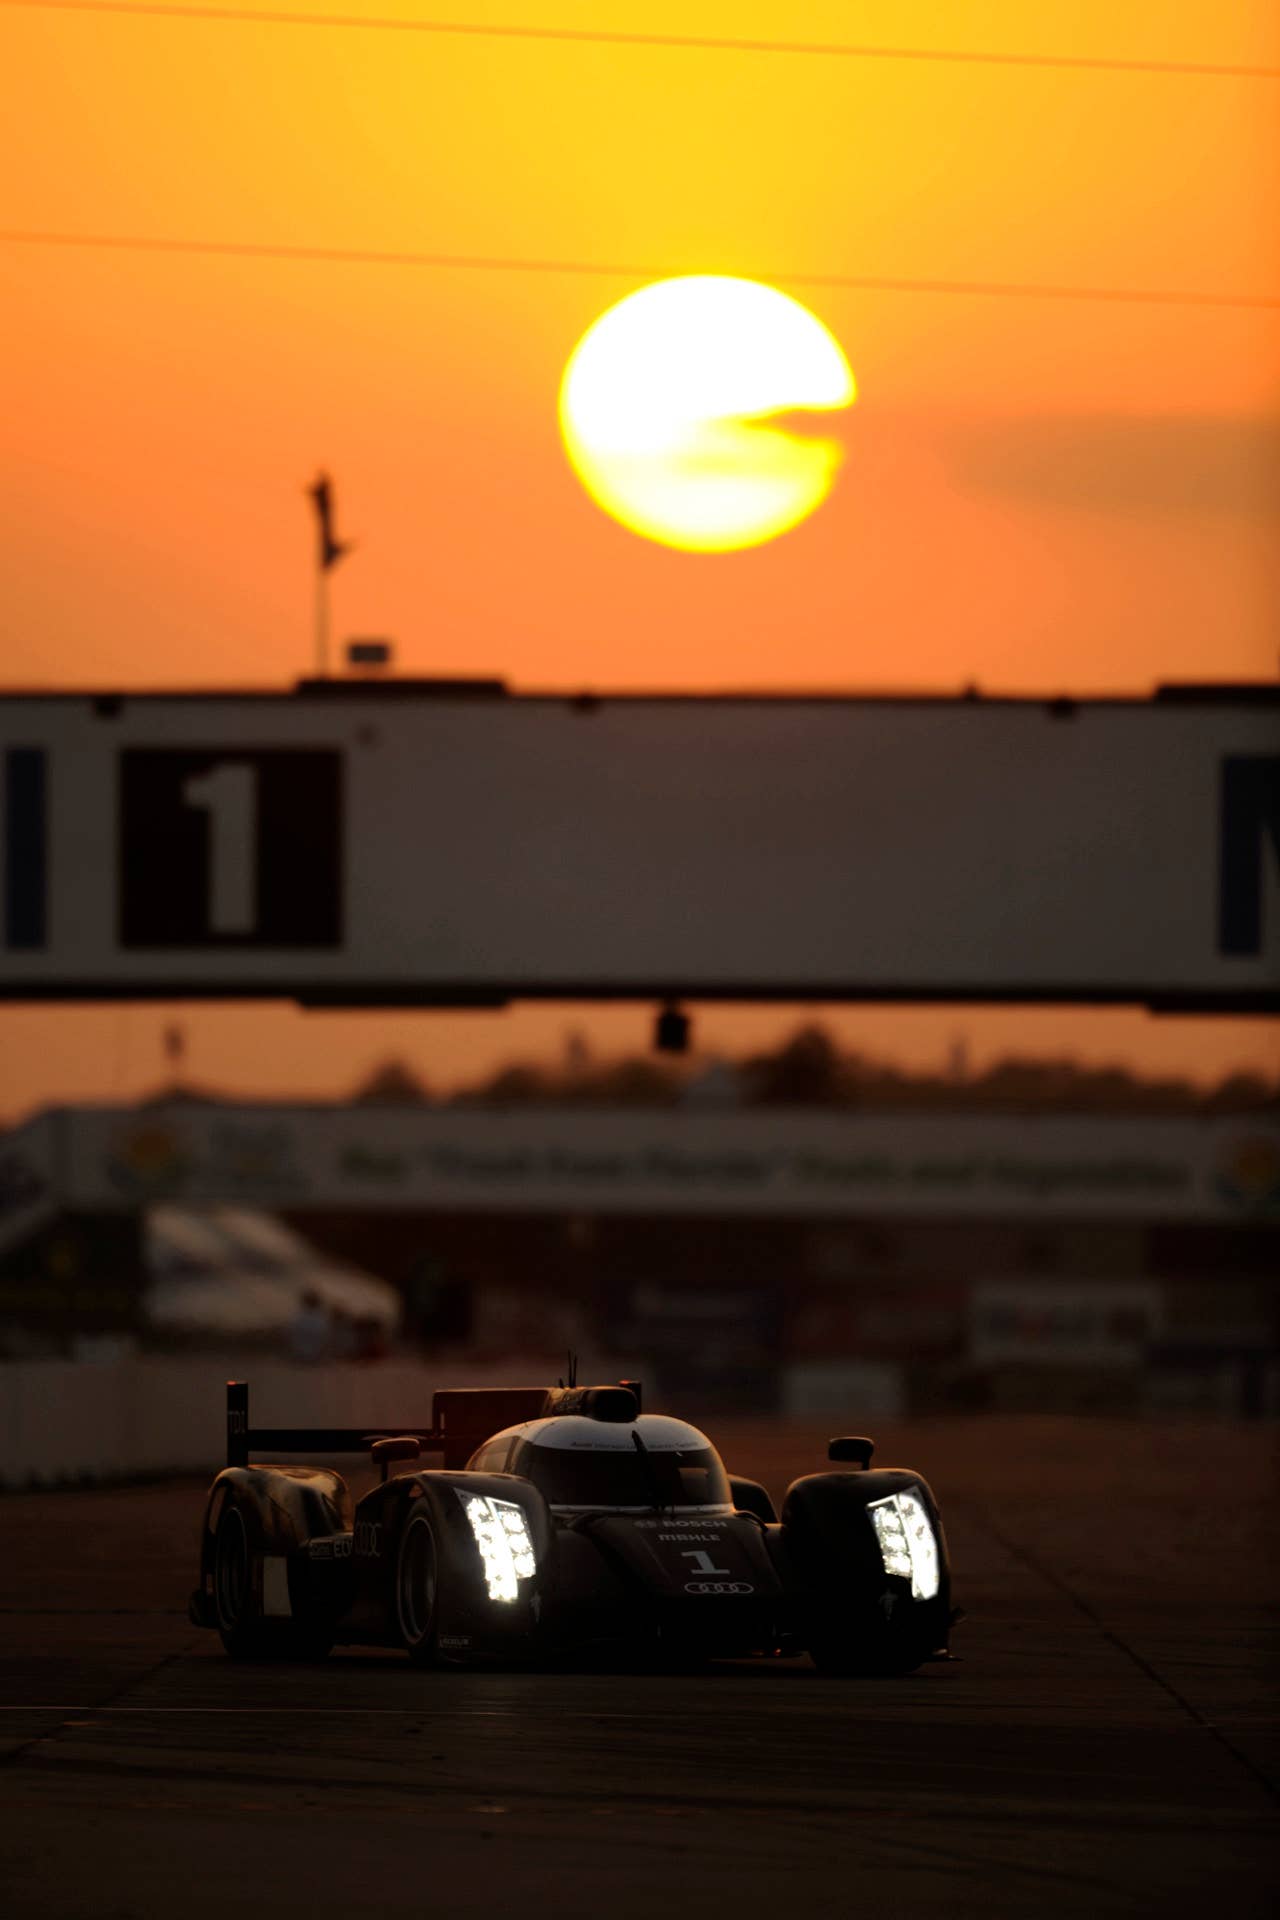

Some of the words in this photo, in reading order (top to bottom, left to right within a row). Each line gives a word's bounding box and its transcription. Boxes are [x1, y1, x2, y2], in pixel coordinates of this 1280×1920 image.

[182, 763, 261, 936] 1
[662, 1519, 728, 1528] BOSCH
[657, 1533, 721, 1541] MAHLE
[680, 1550, 731, 1575] 1
